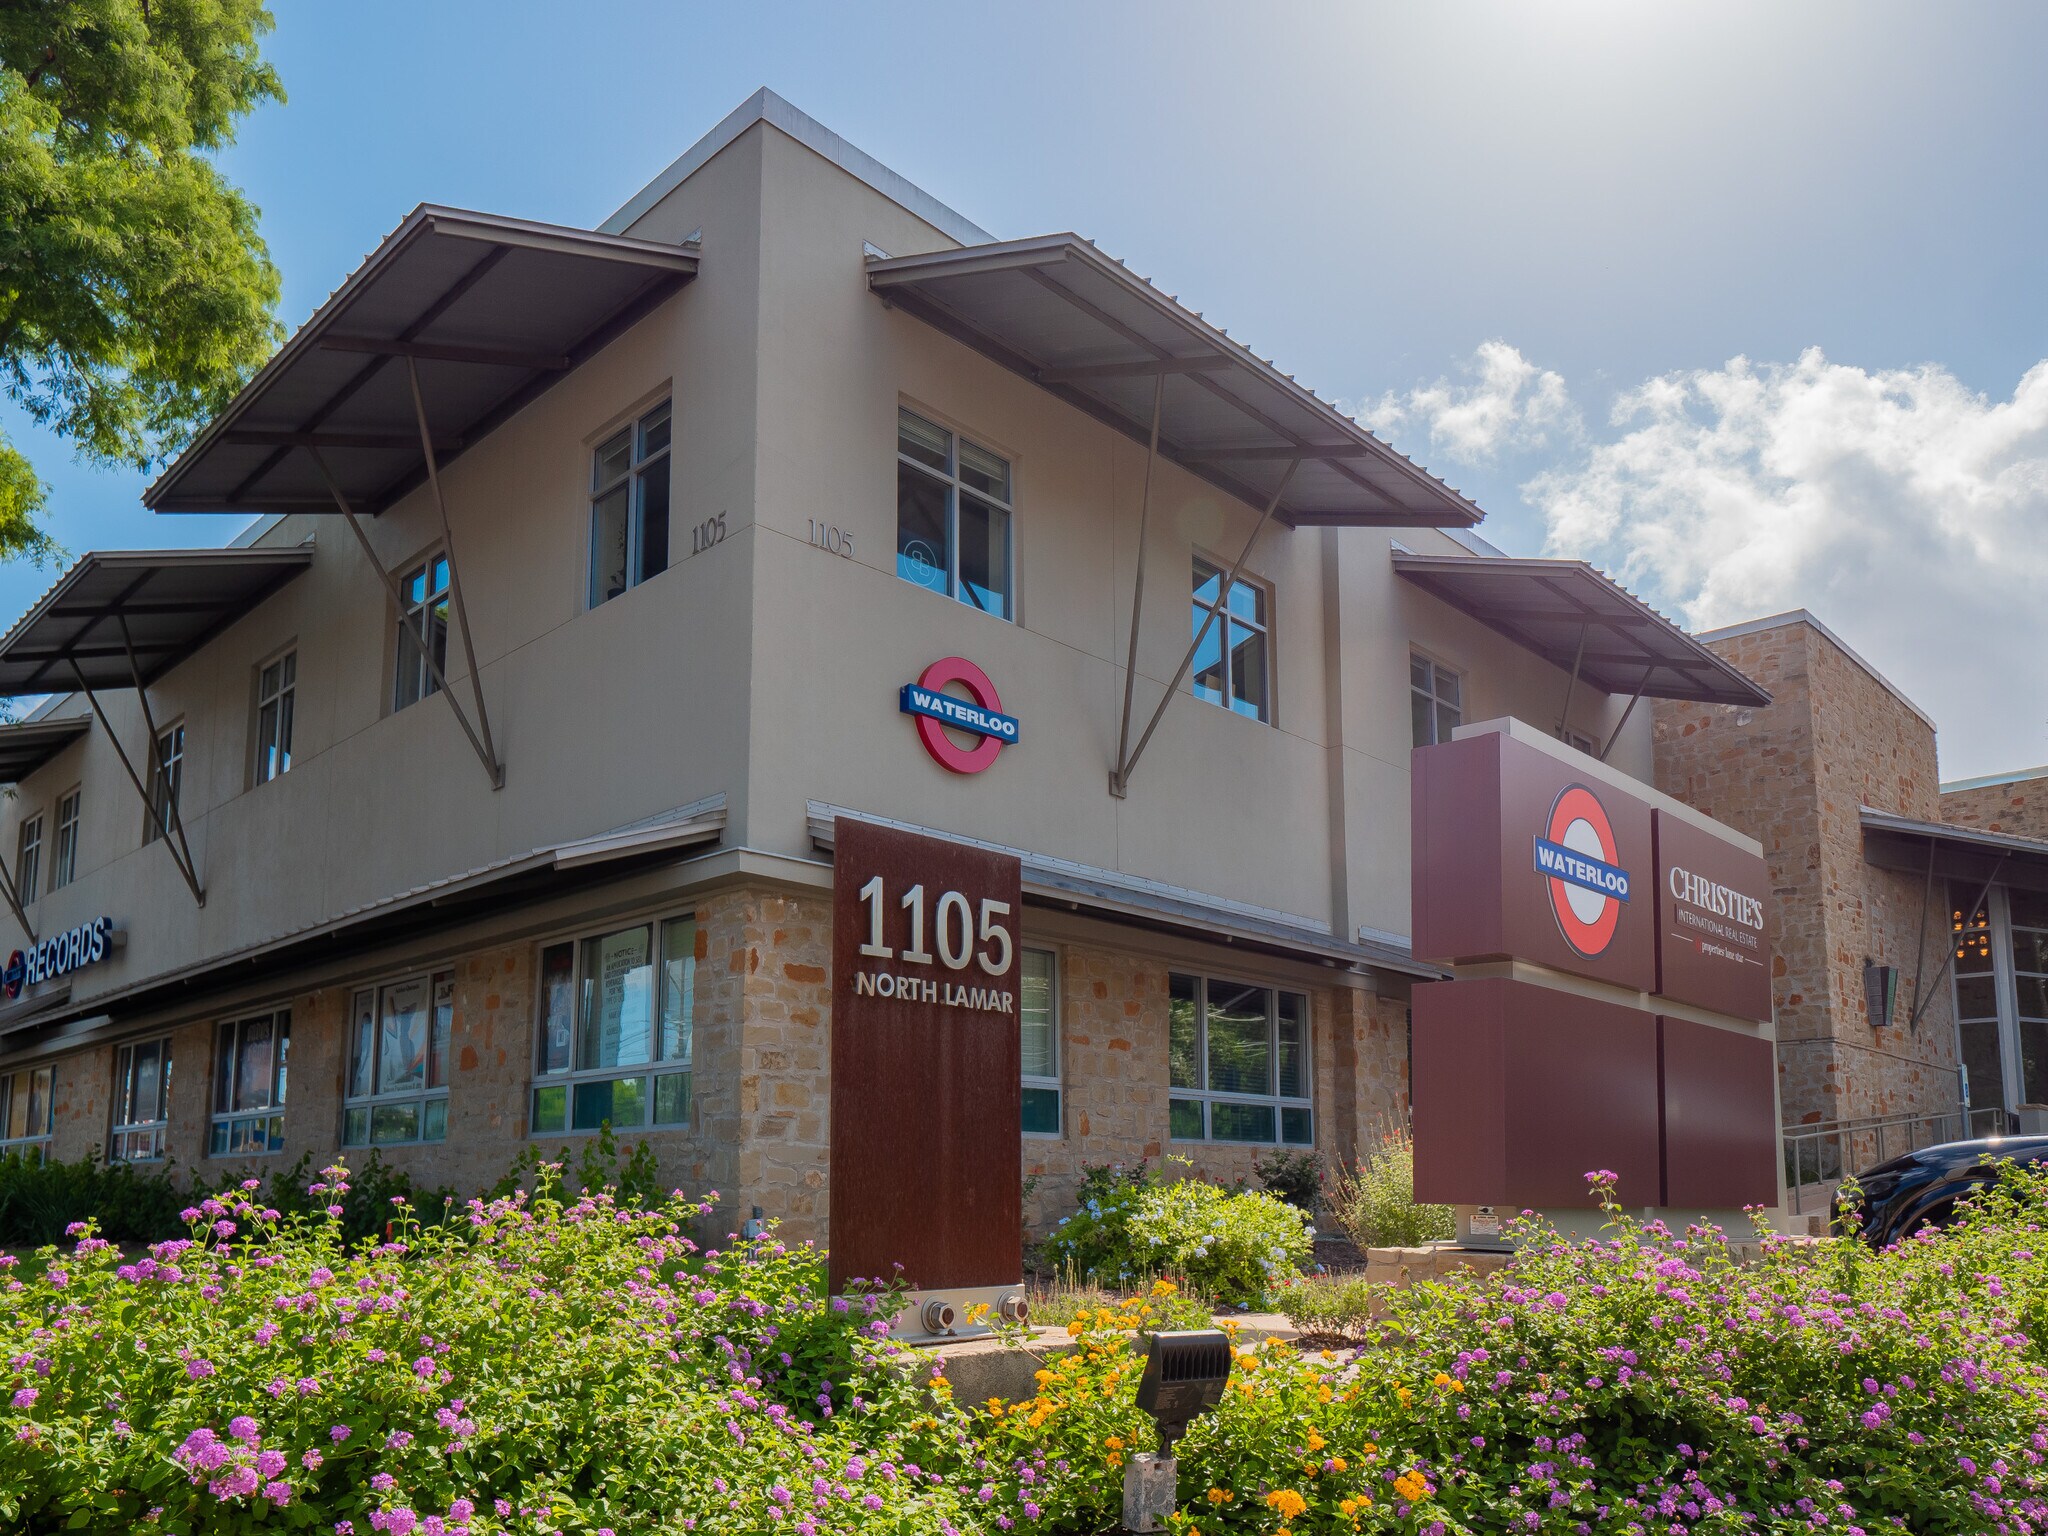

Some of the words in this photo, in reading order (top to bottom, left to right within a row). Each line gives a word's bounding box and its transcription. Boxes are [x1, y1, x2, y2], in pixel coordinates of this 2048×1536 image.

[692, 510, 727, 554] 1105
[808, 518, 855, 558] 1105
[913, 691, 1015, 736] WATERLOO
[1538, 846, 1628, 895] WATERLOO
[1669, 866, 1764, 930] CHRISTIE'S
[859, 875, 1013, 976] 1105
[1678, 909, 1724, 937] INTERNATIONAL
[1725, 926, 1739, 941] REAL
[1740, 932, 1758, 949] ESTATE
[26, 916, 108, 986] RECORDS
[857, 971, 937, 1003] NORTH
[945, 983, 1014, 1014] LAMAR
